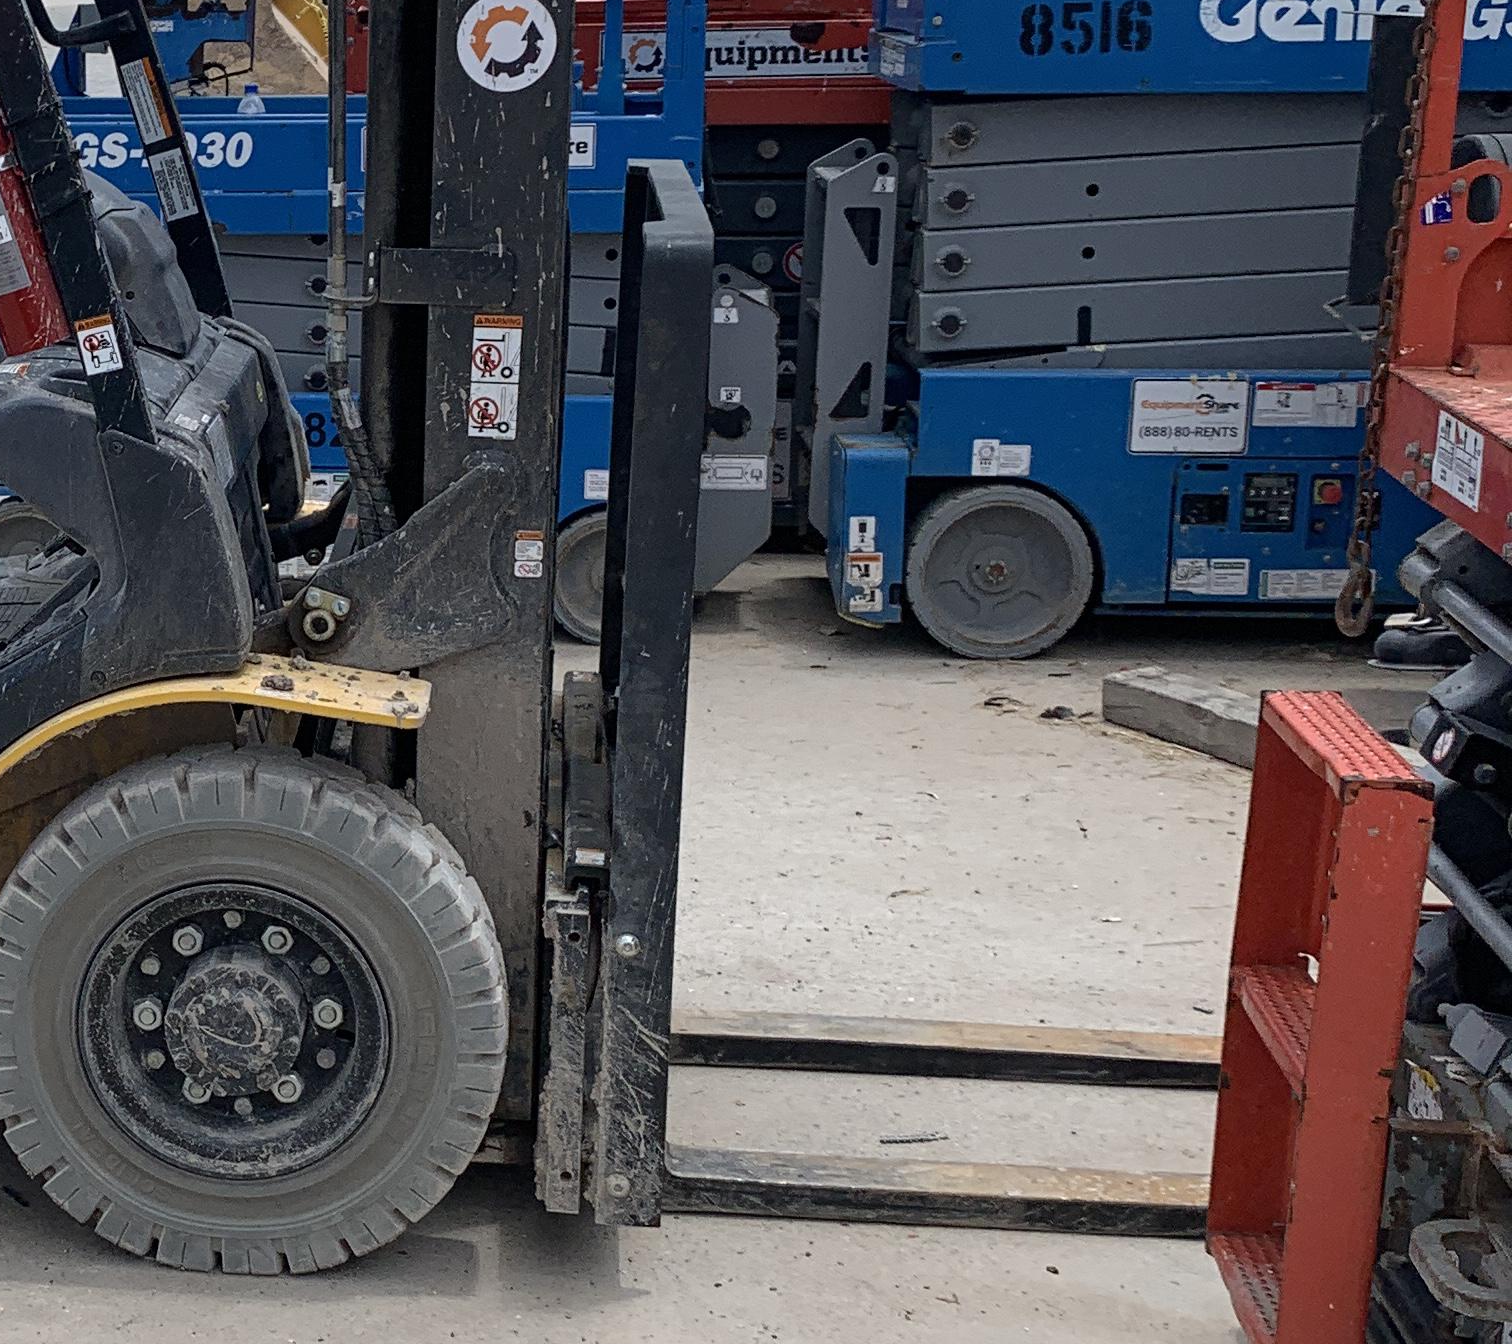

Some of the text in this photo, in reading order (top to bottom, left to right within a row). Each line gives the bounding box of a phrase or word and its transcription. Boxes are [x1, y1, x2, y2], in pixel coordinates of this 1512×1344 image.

[1019, 0, 1153, 56] 8516
[1138, 425, 1239, 439] (888) 80-RENTS
